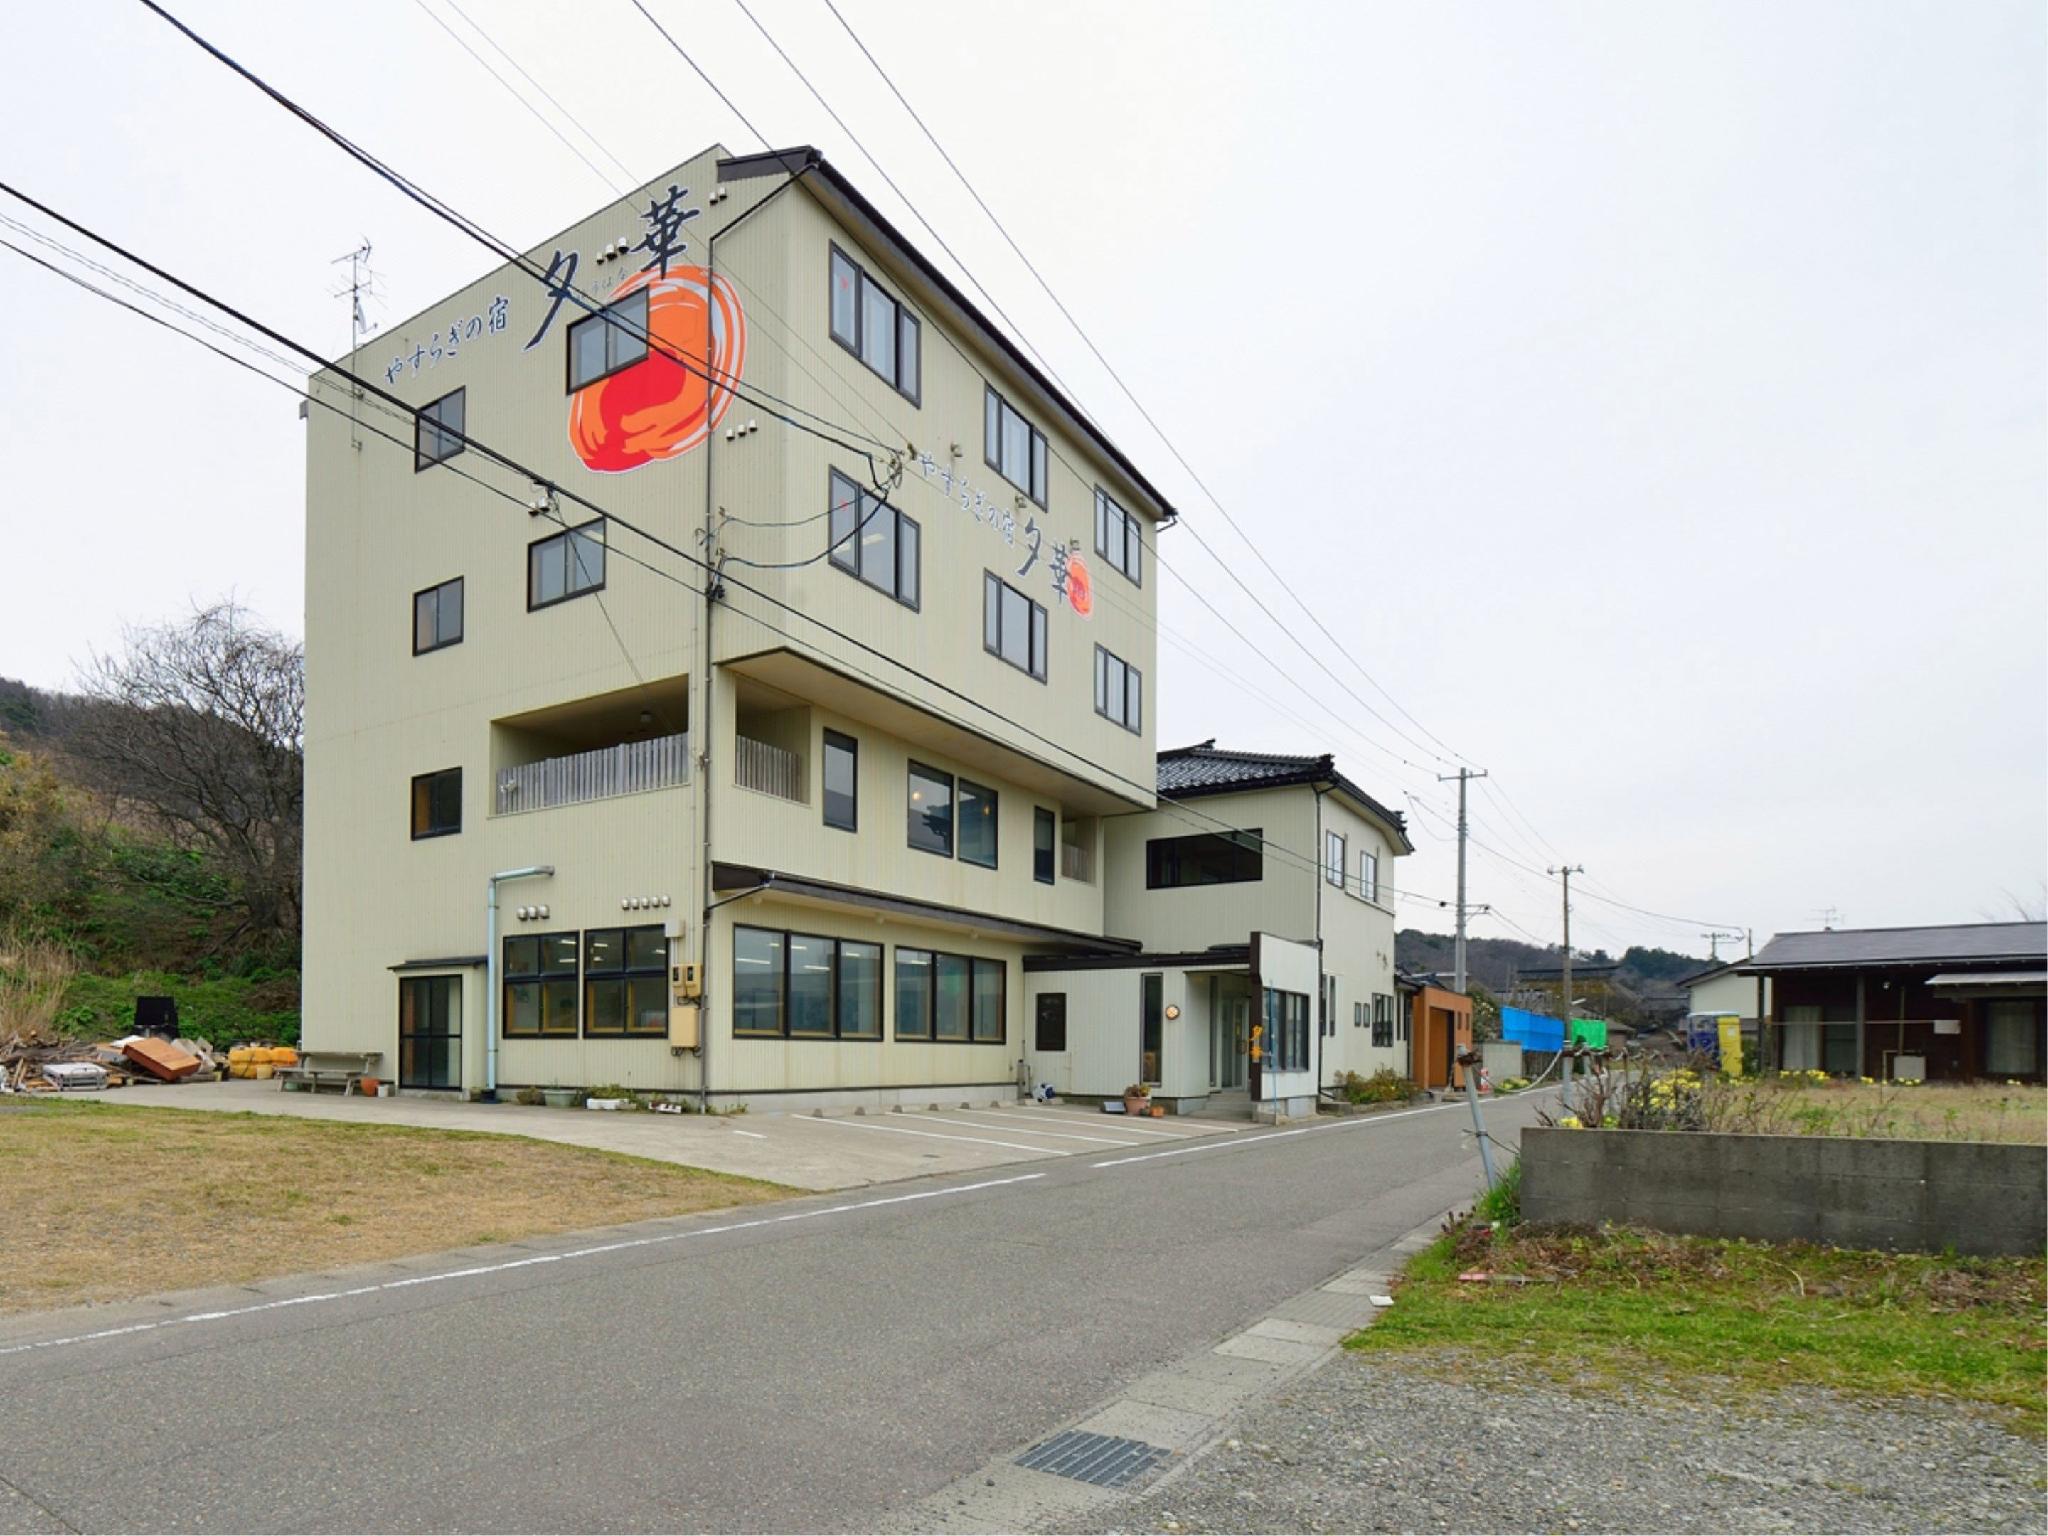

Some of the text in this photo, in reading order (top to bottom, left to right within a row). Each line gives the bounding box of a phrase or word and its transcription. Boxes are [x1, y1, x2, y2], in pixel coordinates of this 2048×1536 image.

[383, 184, 701, 385] やすらぎの宿 夕華
